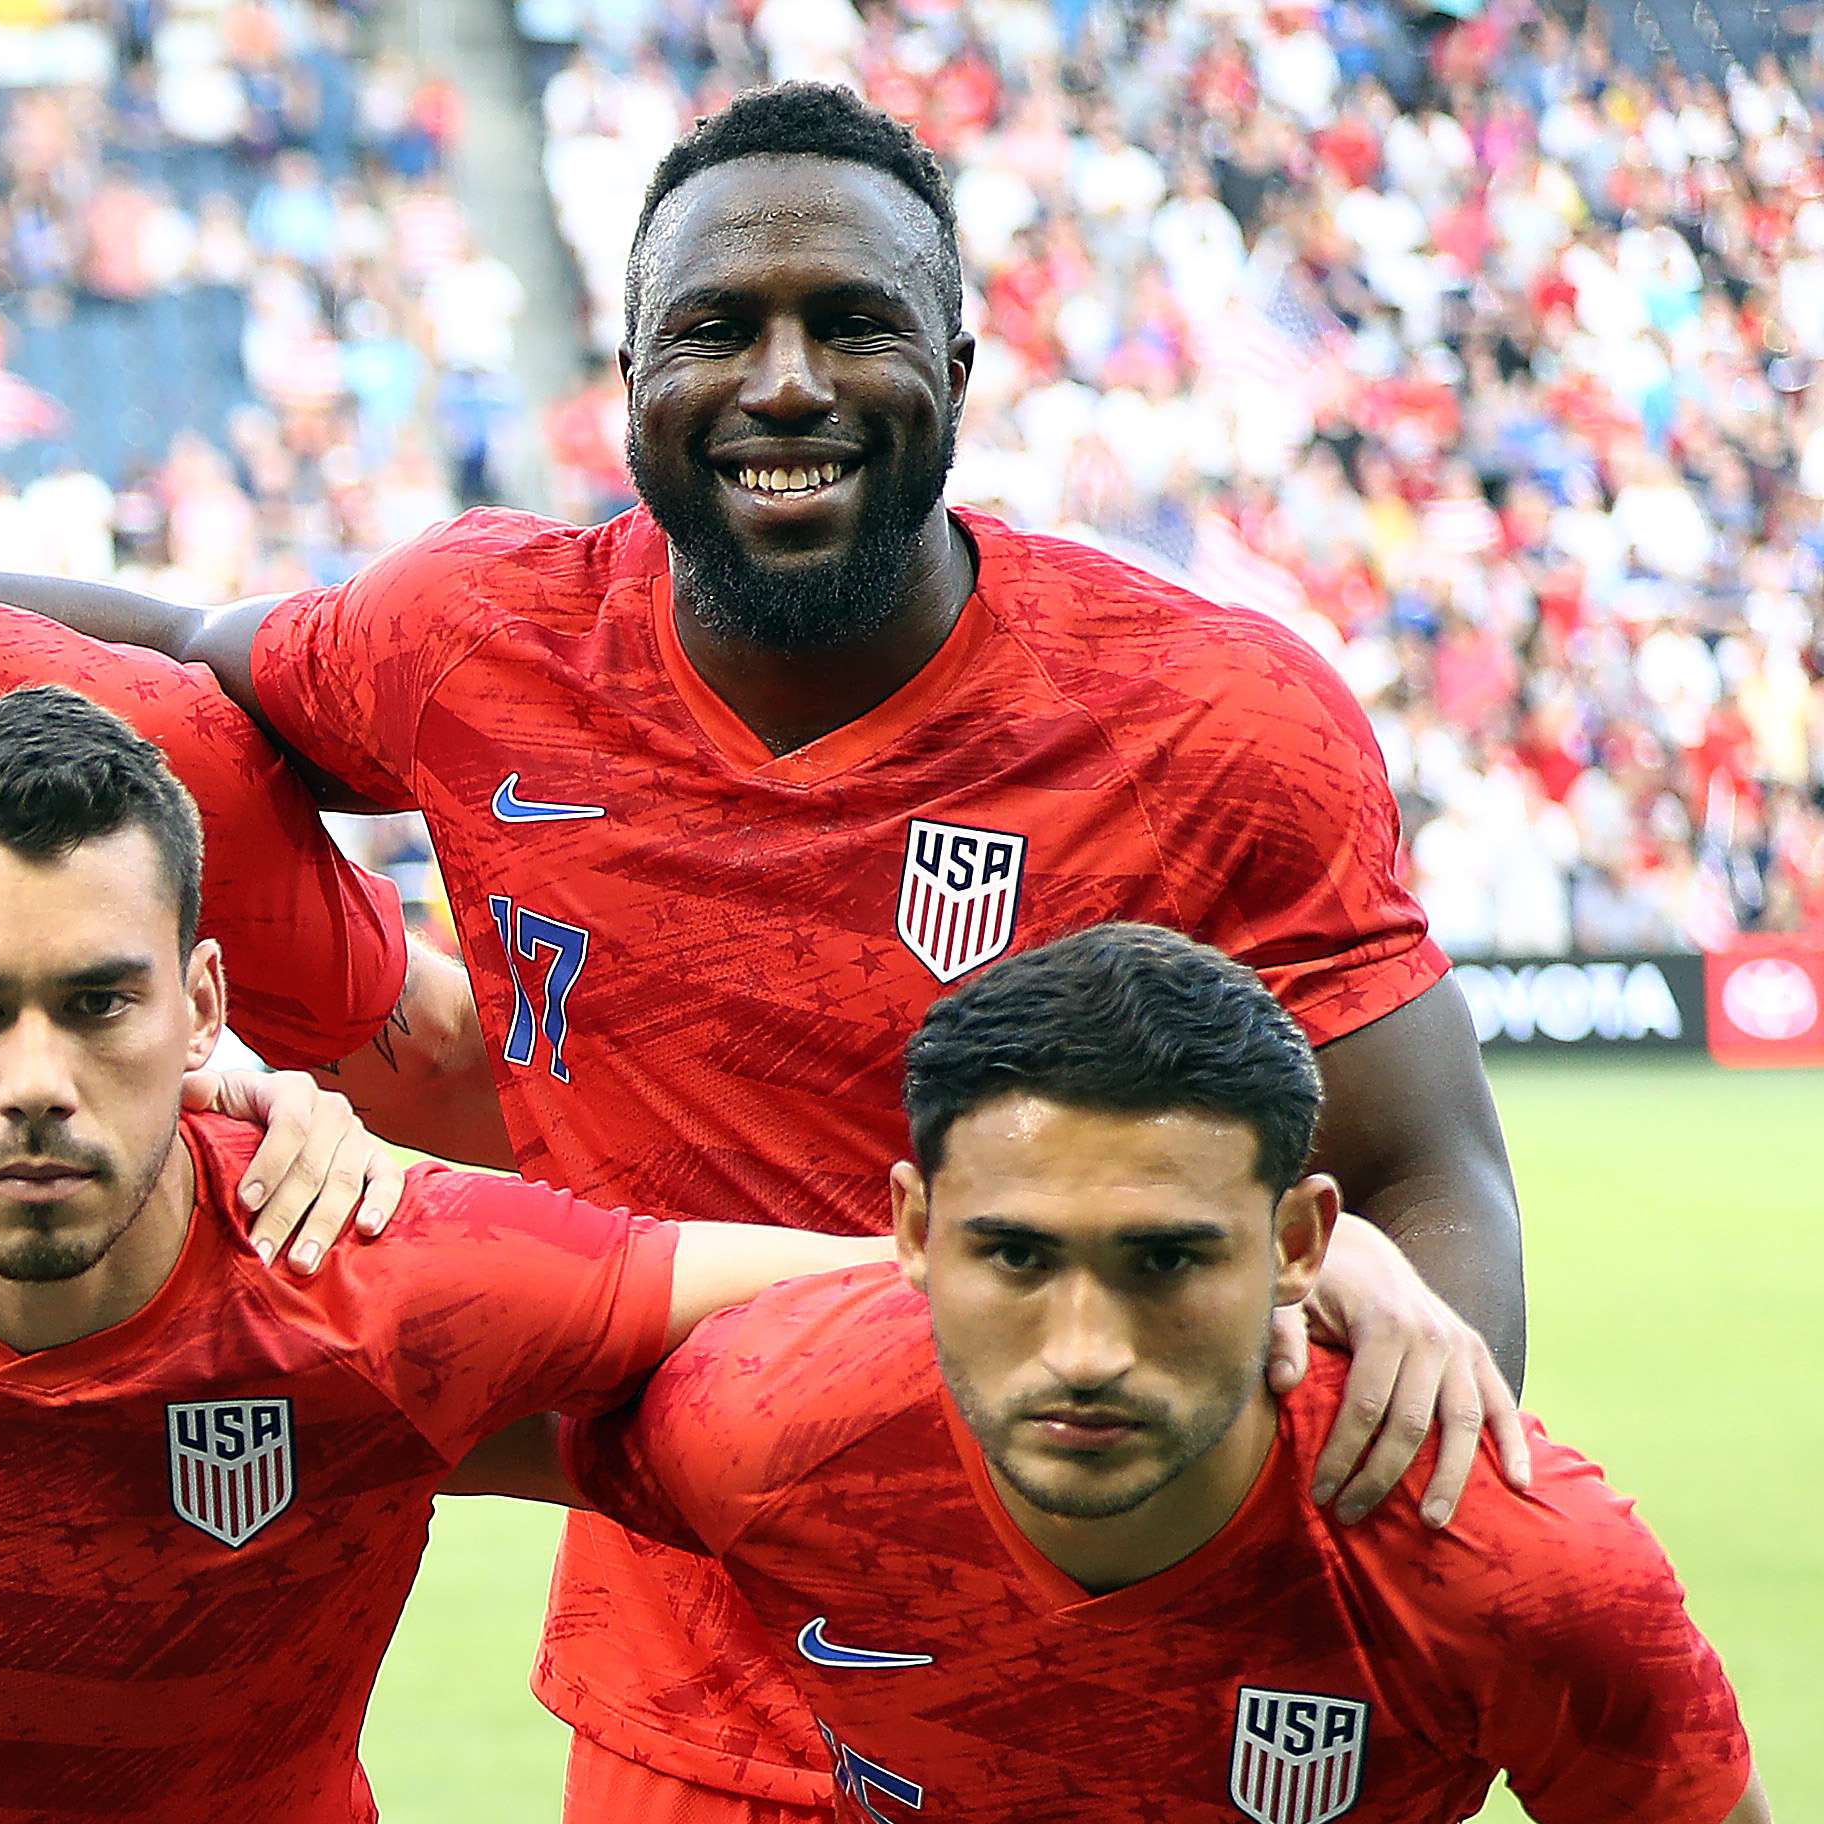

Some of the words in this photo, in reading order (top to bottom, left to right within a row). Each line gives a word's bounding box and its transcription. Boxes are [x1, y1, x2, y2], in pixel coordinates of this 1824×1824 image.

[915, 828, 1013, 892] USA
[488, 894, 590, 1083] 17
[1453, 961, 1683, 1042] OYOTA
[175, 1405, 282, 1461] USA
[1244, 1696, 1358, 1757] USA
